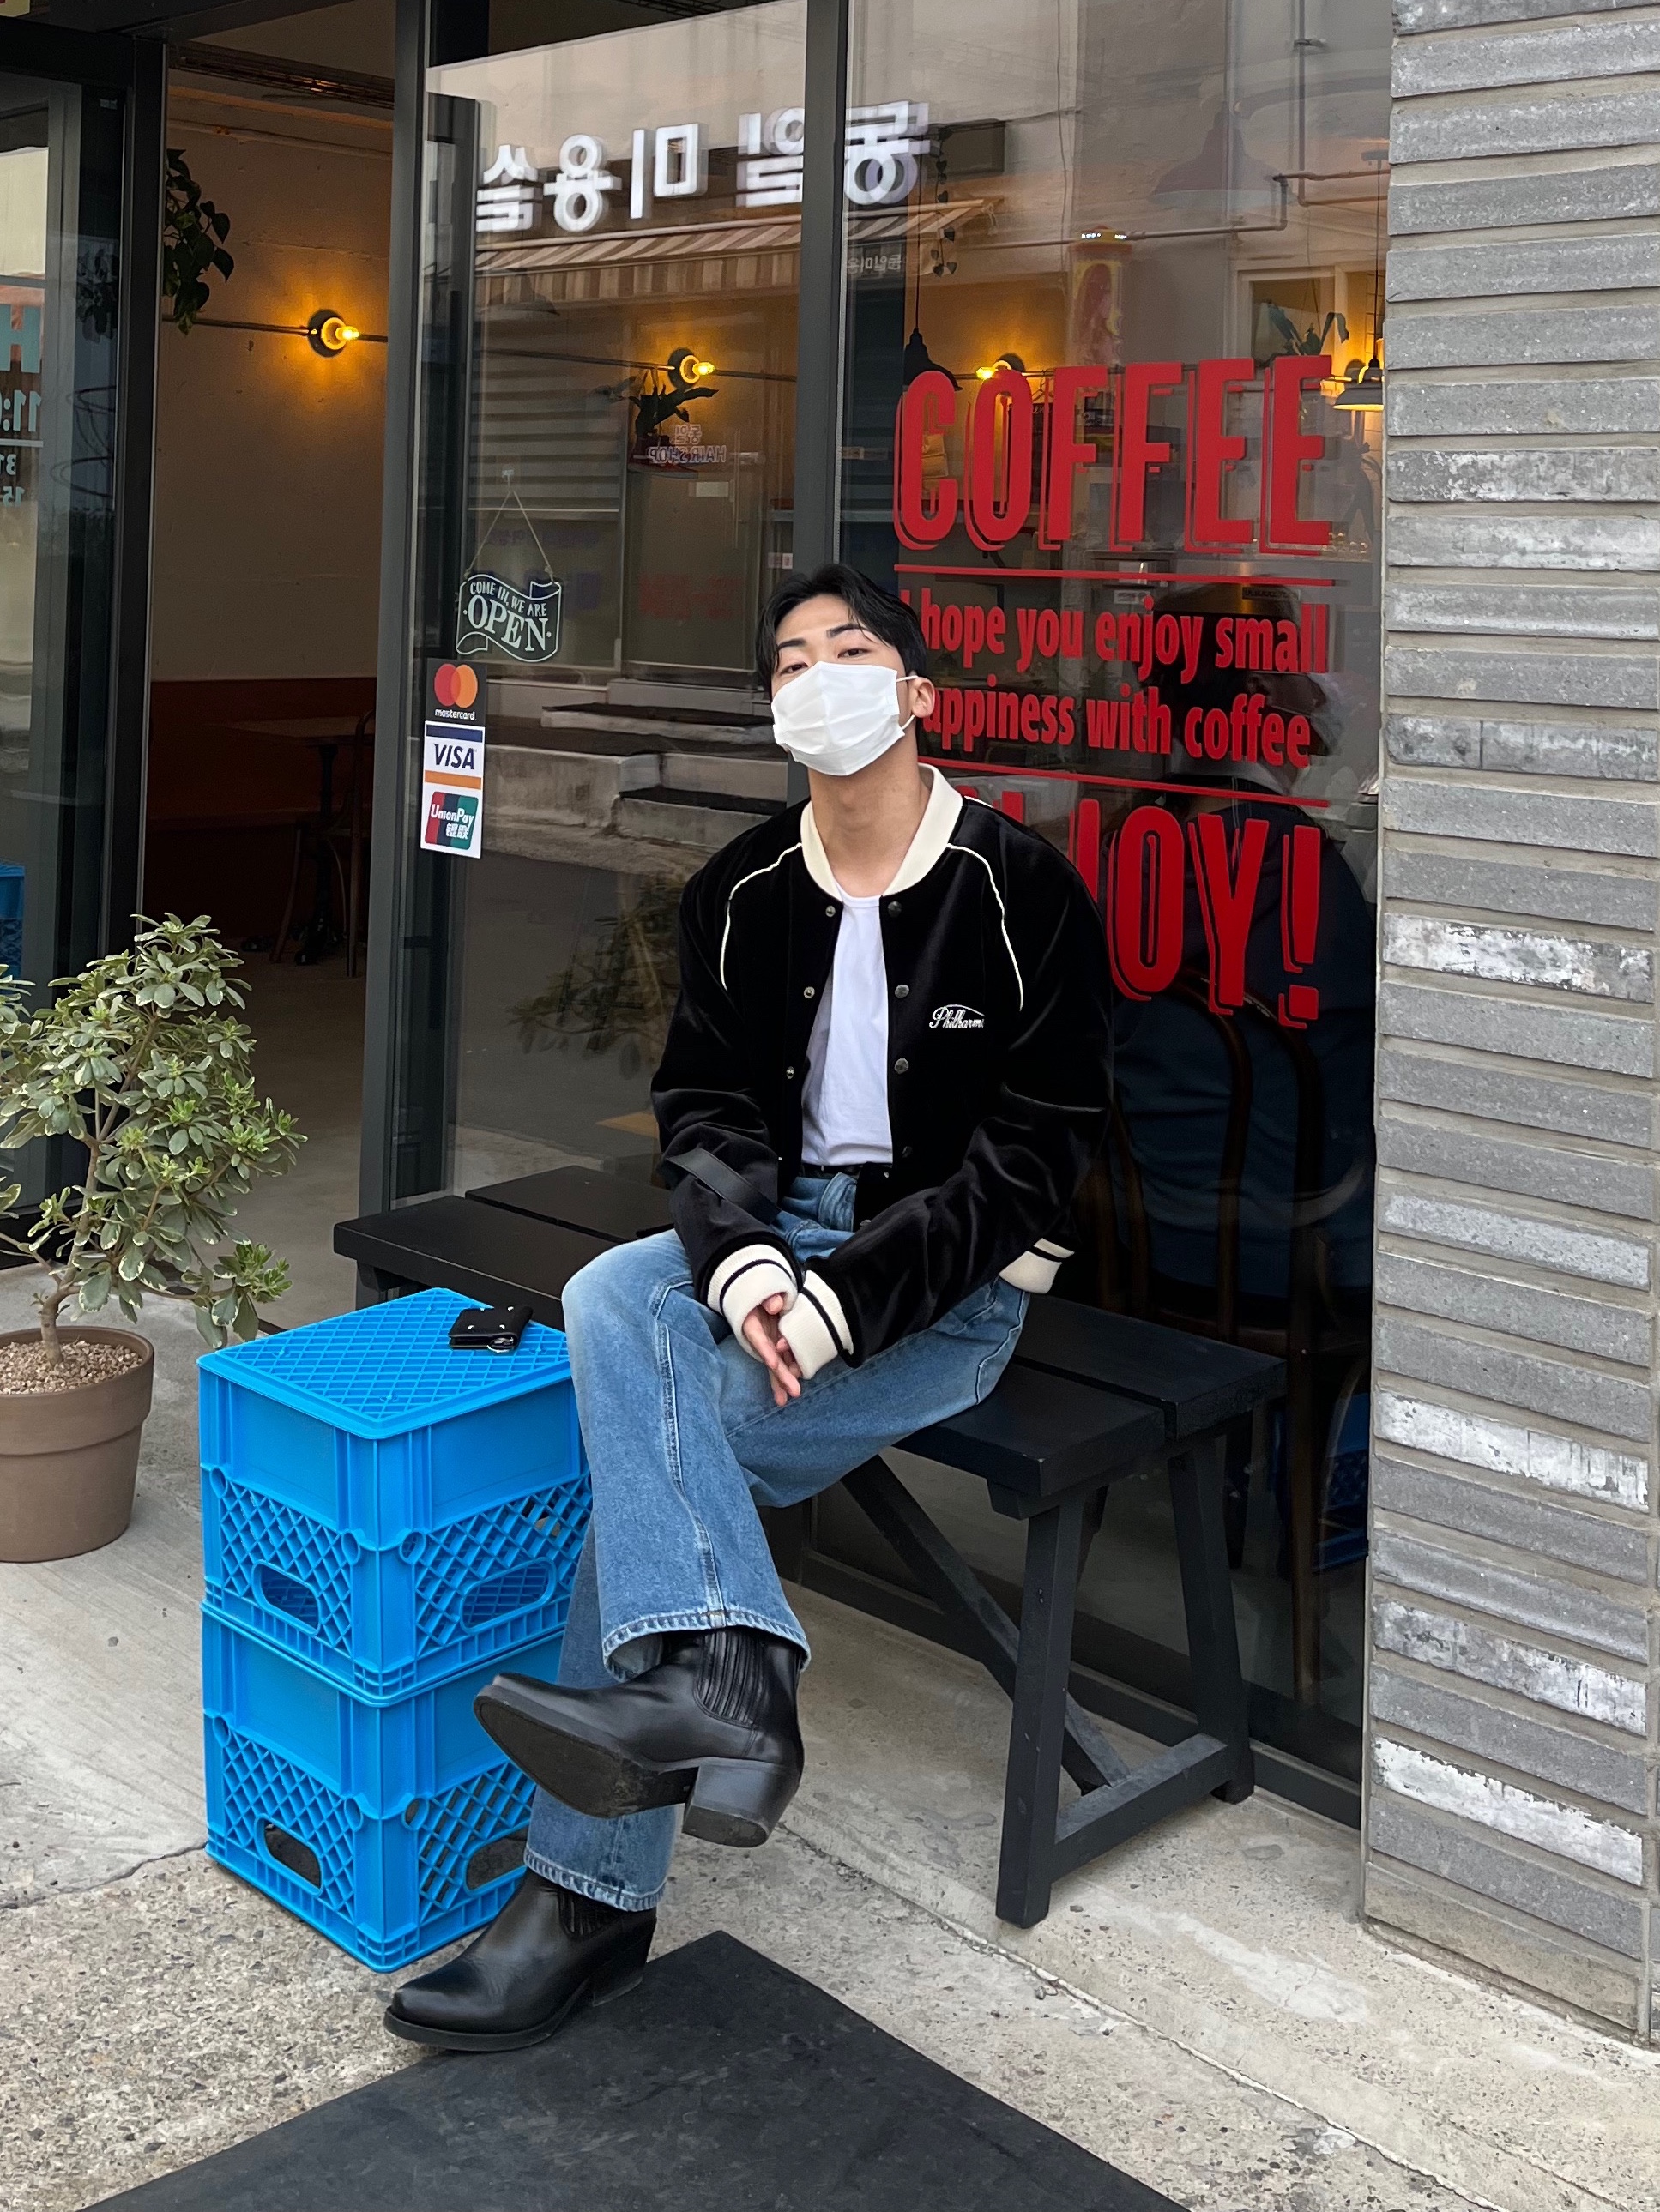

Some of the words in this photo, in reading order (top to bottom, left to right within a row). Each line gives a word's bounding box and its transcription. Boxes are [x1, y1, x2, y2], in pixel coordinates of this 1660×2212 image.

[893, 354, 1333, 557] COFFEE
[469, 581, 496, 595] COME
[511, 596, 525, 613] WE
[527, 603, 547, 617] ARE
[468, 594, 549, 652] OPEN
[921, 588, 1006, 669] hope
[1016, 607, 1084, 673] you
[1094, 594, 1204, 684] enjoy
[1215, 603, 1329, 674] small
[434, 708, 475, 720] mastercard
[923, 674, 1076, 752] appiness
[1086, 683, 1172, 755] with
[1184, 693, 1311, 768] coffee
[433, 743, 475, 770] VISA
[431, 803, 474, 828] UnionPay
